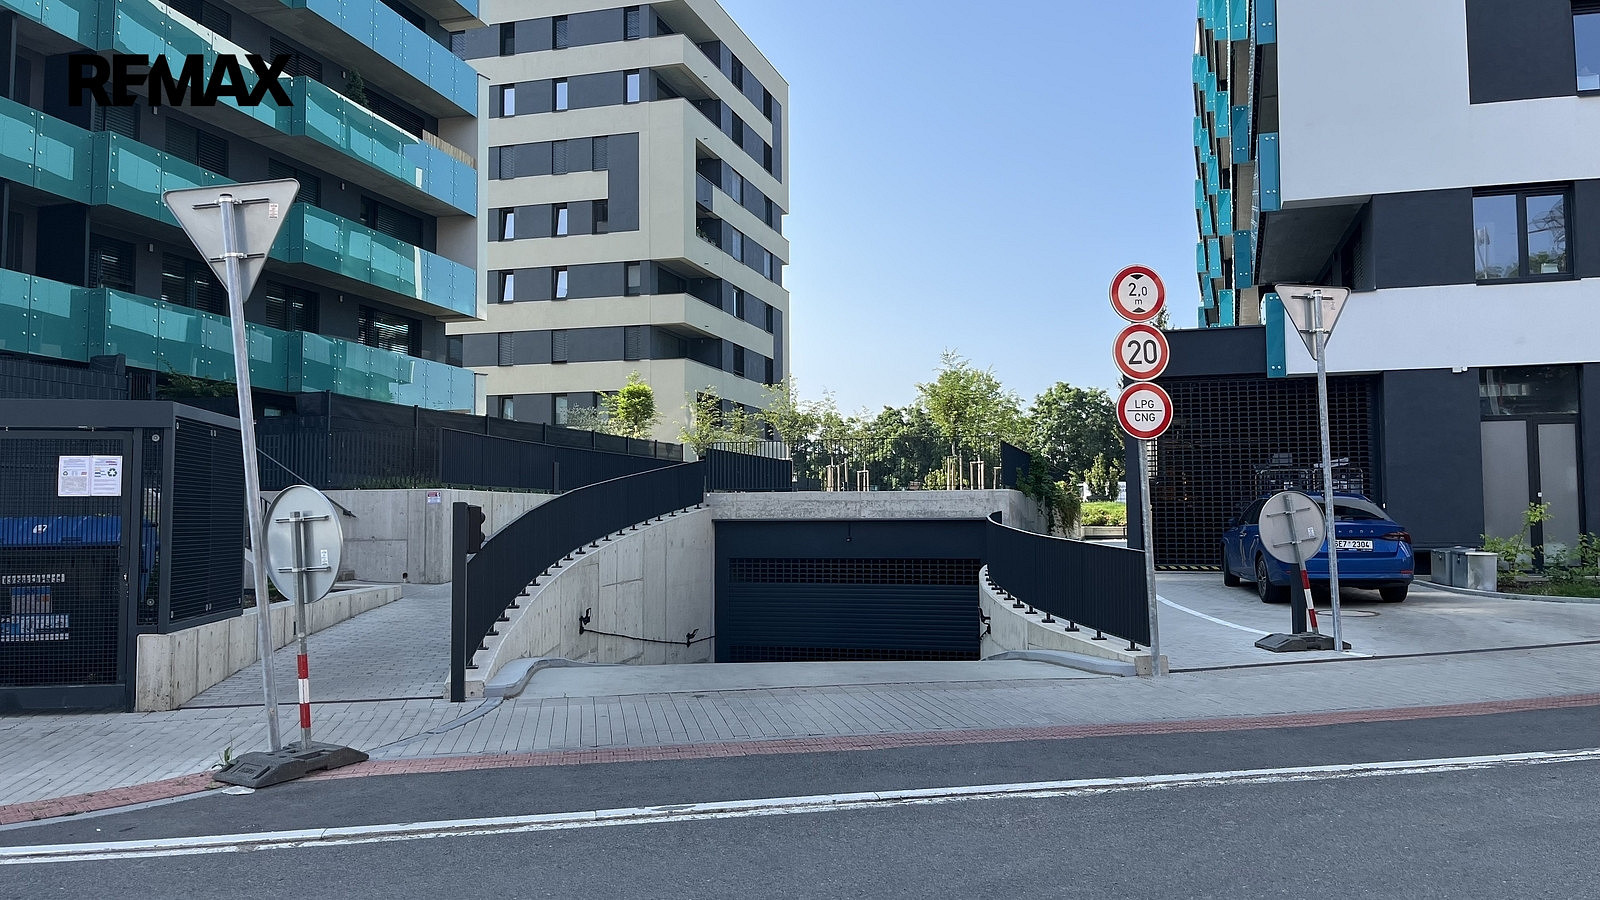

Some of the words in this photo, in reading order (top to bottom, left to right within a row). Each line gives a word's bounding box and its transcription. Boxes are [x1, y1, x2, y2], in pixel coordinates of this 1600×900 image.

[1128, 282, 1148, 297] 2,0
[1127, 339, 1158, 365] 20
[1134, 399, 1155, 409] LPG
[1134, 412, 1156, 422] CNG
